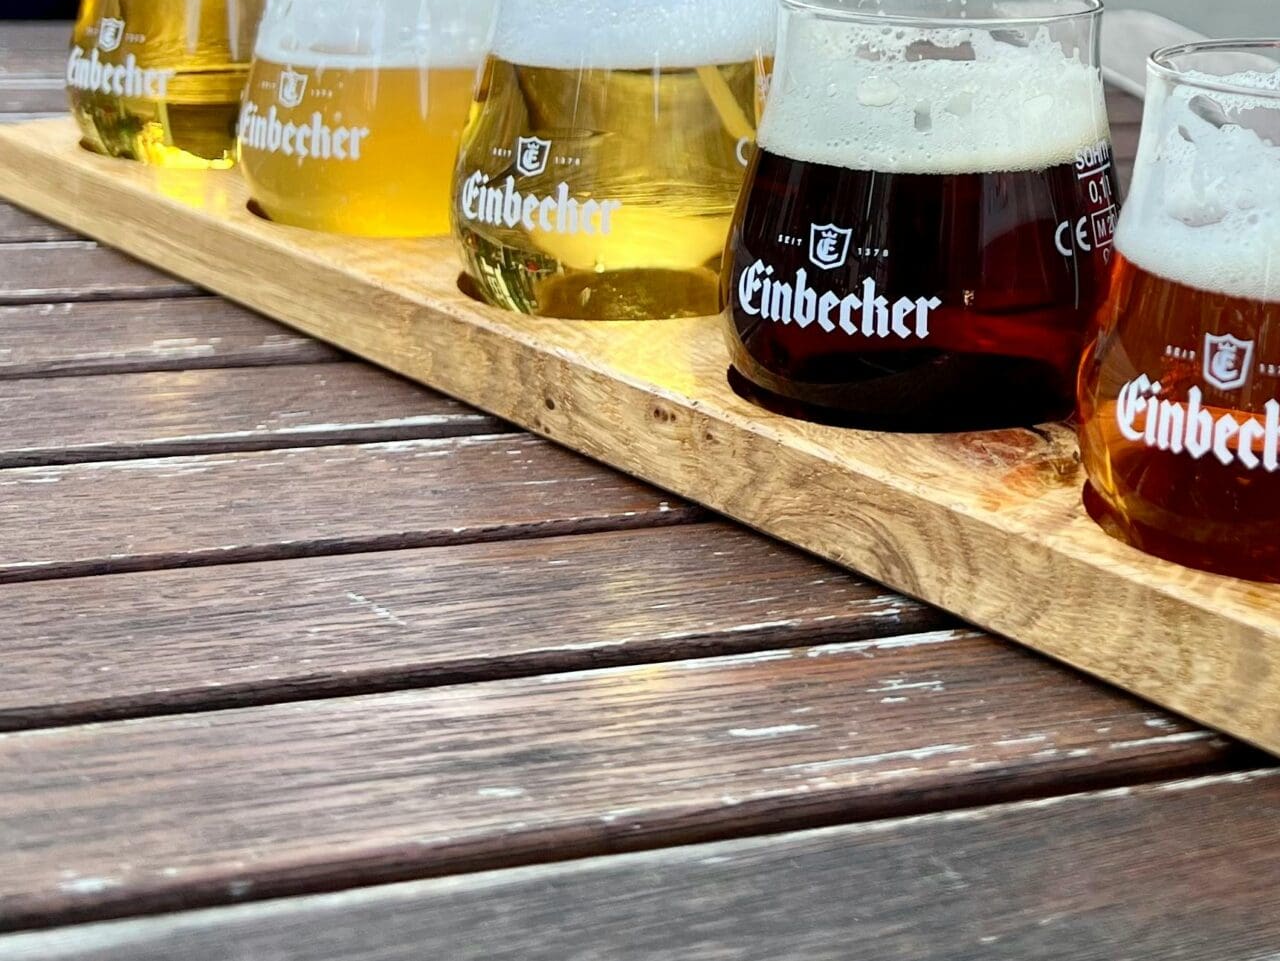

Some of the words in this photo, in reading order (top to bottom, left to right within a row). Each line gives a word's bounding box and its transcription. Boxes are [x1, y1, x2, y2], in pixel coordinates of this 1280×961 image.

[67, 45, 175, 98] Einbecker
[238, 101, 369, 160] Einbecker
[462, 169, 622, 235] Einbecker
[777, 234, 802, 246] SEIT
[857, 247, 889, 257] 1378
[738, 258, 942, 339] Einbecker
[1165, 344, 1196, 360] SEIT
